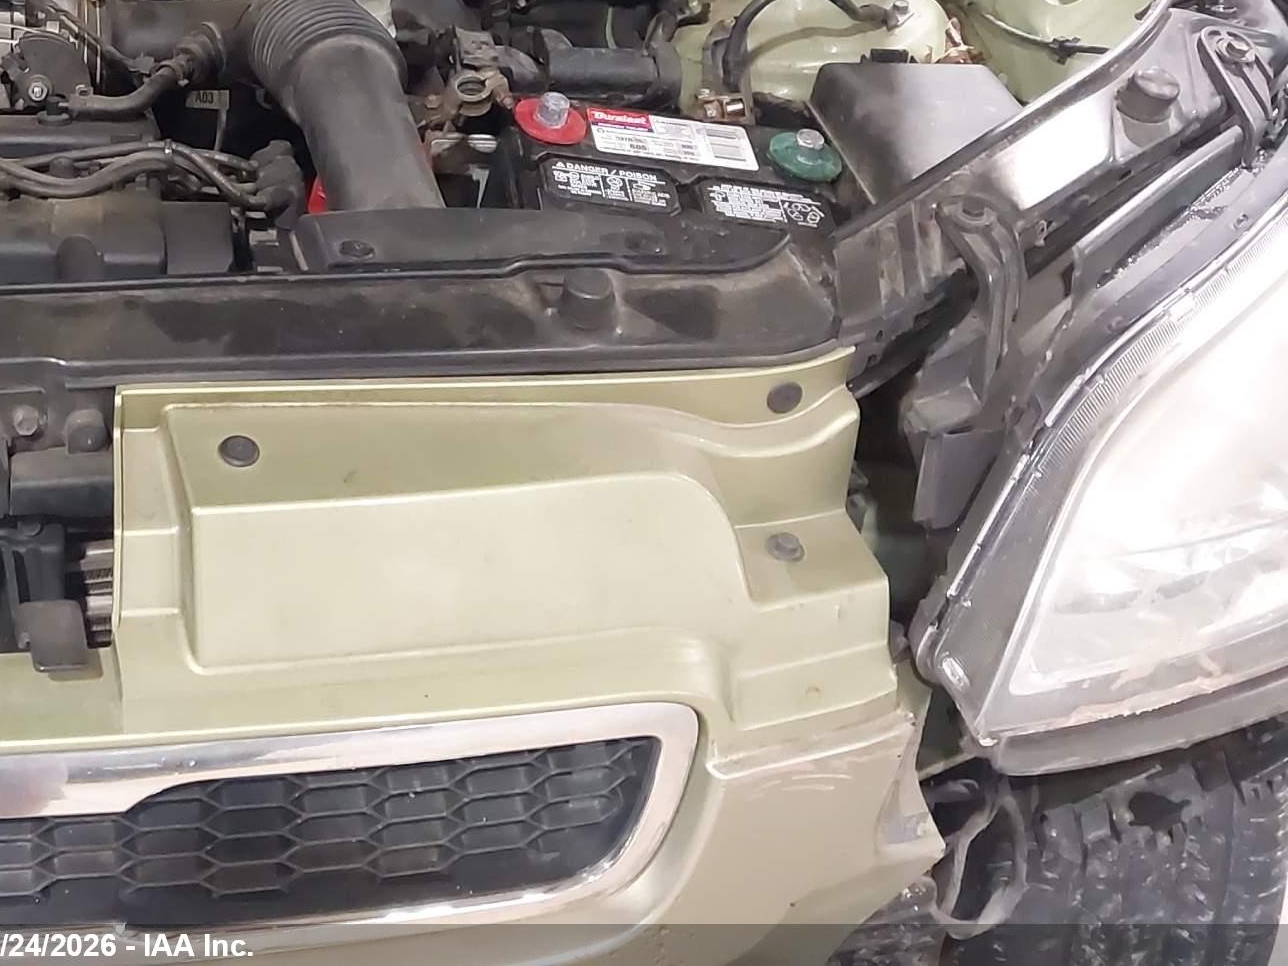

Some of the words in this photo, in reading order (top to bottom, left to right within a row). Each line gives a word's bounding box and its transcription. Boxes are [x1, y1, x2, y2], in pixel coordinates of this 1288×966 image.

[591, 111, 647, 125] Duralast
[566, 162, 609, 176] DANGER
[619, 170, 658, 183] POISON
